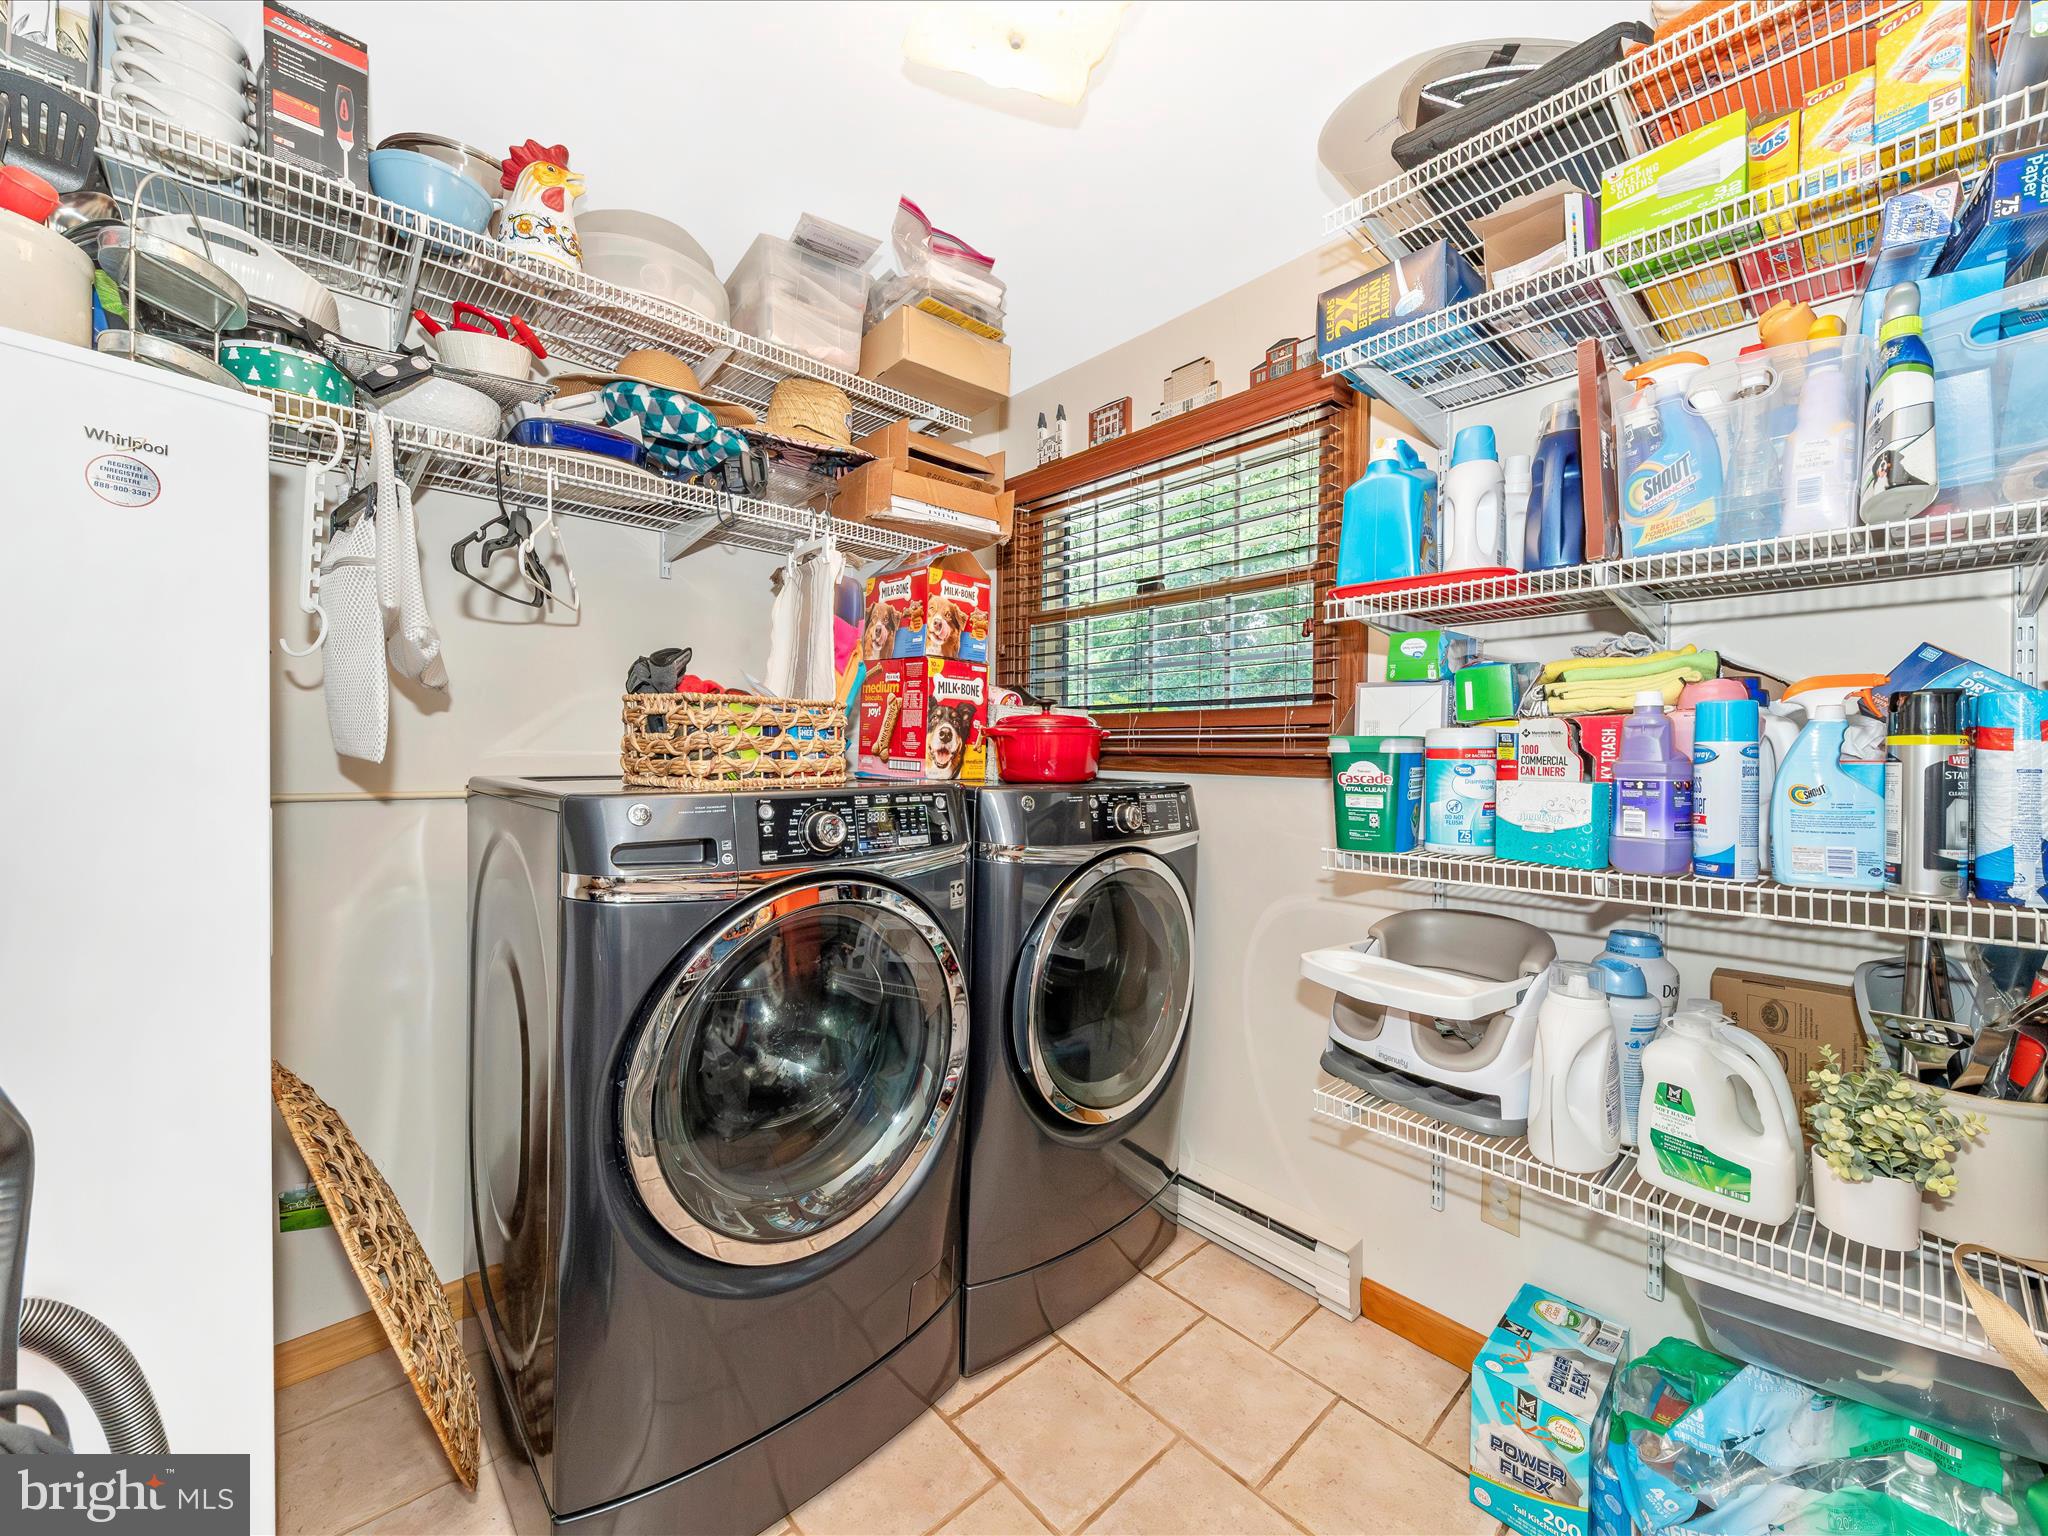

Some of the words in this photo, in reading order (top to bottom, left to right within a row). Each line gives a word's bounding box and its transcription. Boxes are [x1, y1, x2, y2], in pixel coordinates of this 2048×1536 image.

[271, 16, 333, 49] Snap-on
[1879, 4, 1923, 38] GLAD
[1806, 82, 1845, 107] GLAD
[1932, 92, 1959, 113] 56
[1610, 162, 1661, 194] SWEEPING
[1616, 176, 1656, 200] CLOTHS
[1712, 179, 1744, 195] 32
[2001, 195, 2020, 216] 75
[1886, 201, 1902, 241] Reynolds
[1334, 287, 1359, 339] 2X
[1359, 283, 1369, 330] BETTER
[1368, 277, 1382, 326] THAN
[1326, 298, 1336, 342] CLEANS
[1381, 309, 1390, 319] A
[84, 425, 168, 456] Whirlpool
[107, 460, 143, 473] REGISTER
[1642, 452, 1691, 501] SHOUT
[93, 480, 151, 498] 888-900-3381
[1645, 520, 1687, 540] FORMULA
[862, 681, 900, 694] medium
[1521, 745, 1539, 755] 1000
[1601, 727, 1617, 762] TRASH
[1520, 756, 1568, 766] COMMERCIAL
[1520, 766, 1536, 776] CAN
[1537, 767, 1566, 777] LINERS
[1338, 772, 1393, 785] Cascade
[1803, 784, 1827, 800] SHOUT
[1459, 830, 1471, 839] 75
[1547, 1355, 1573, 1395] POWER
[1568, 1367, 1591, 1400] FLEX
[1554, 1419, 1576, 1435] Fresh
[1555, 1426, 1577, 1442] Clean
[1490, 1434, 1567, 1488] POWER
[1499, 1456, 1554, 1500] FLEX
[1512, 1503, 1527, 1518] Tall
[1542, 1508, 1582, 1536] 200
